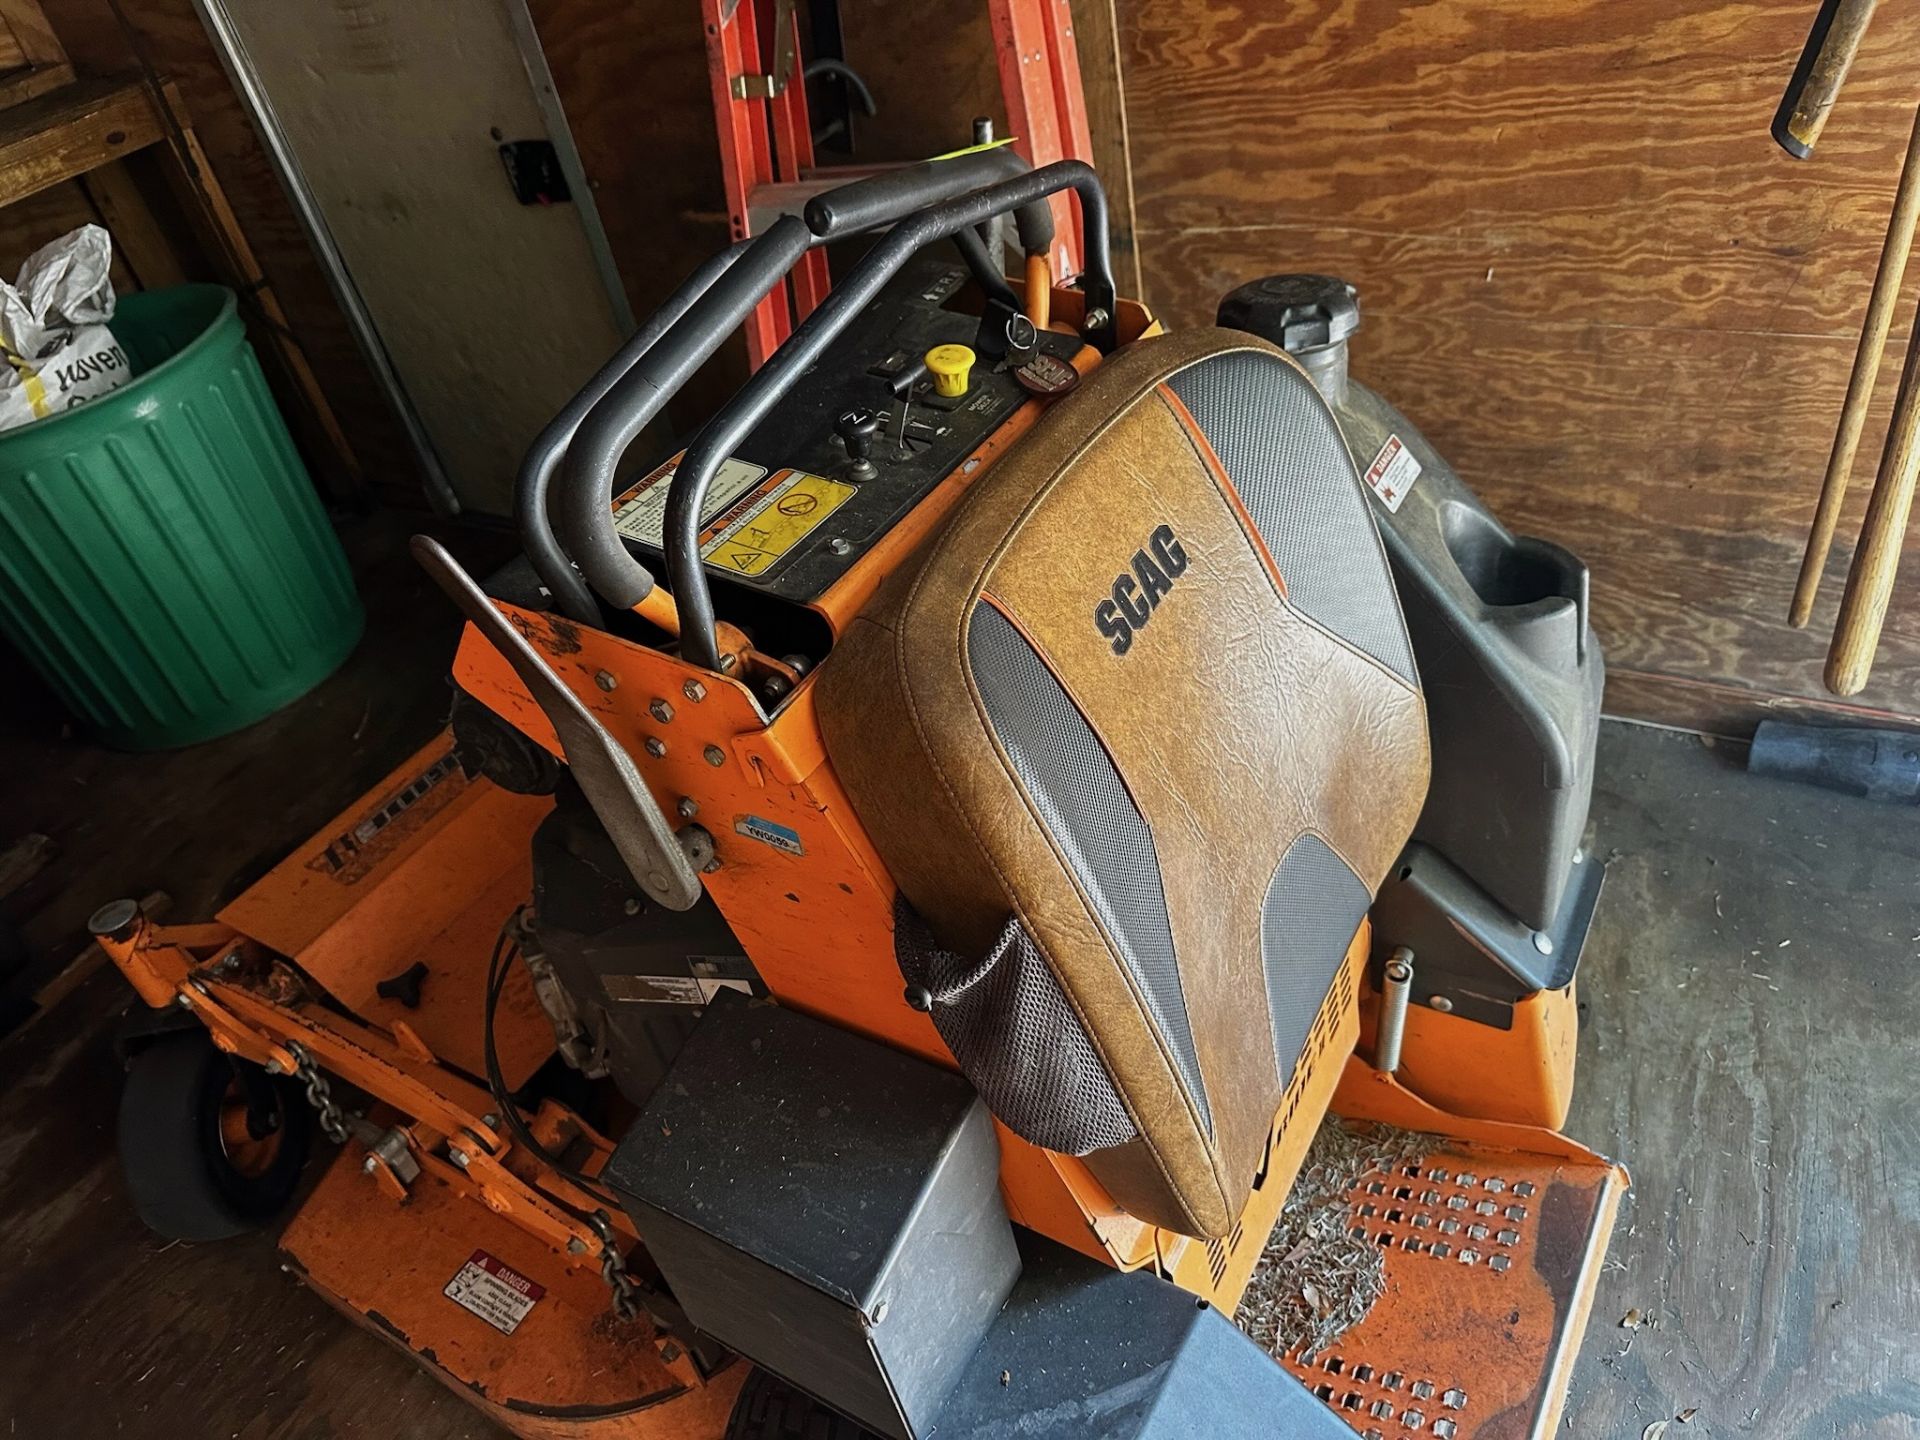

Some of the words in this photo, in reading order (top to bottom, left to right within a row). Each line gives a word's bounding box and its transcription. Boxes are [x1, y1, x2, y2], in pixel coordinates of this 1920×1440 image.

[1375, 443, 1397, 473] DANGER
[632, 462, 677, 493] WARNING
[723, 489, 768, 521] WARNING
[1094, 524, 1188, 656] SCAG
[496, 1267, 531, 1293] DANGER
